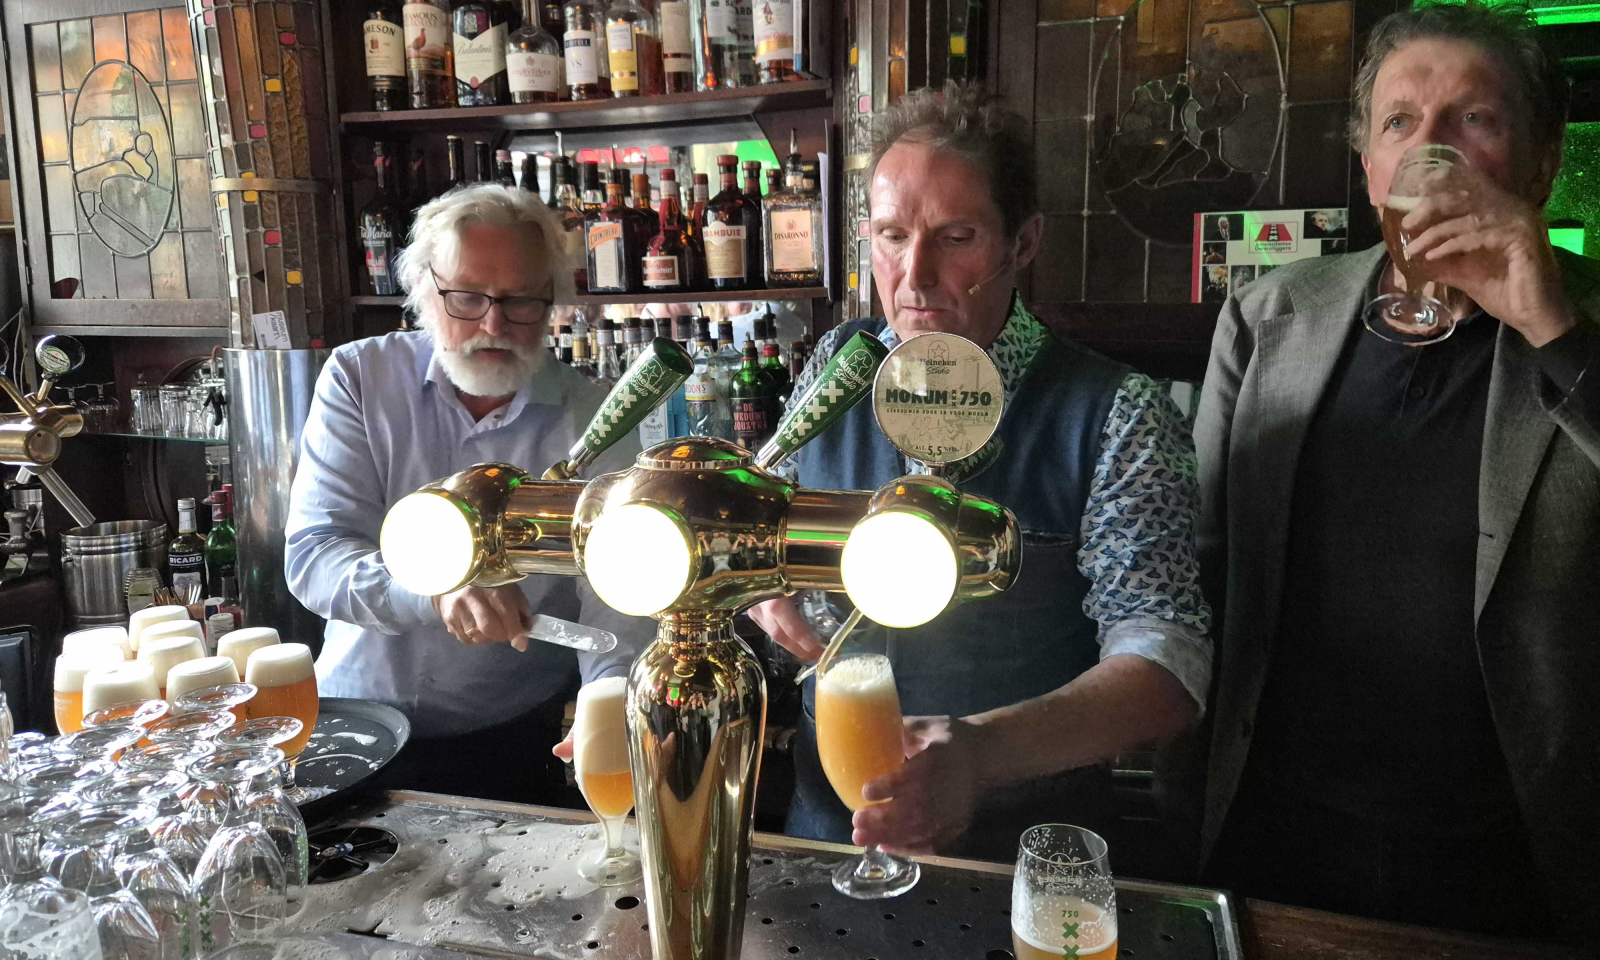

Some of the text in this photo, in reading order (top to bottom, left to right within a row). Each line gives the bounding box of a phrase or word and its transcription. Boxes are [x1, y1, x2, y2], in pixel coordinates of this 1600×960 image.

[590, 228, 619, 247] COINTREAU
[774, 231, 809, 240] DISARONNO
[926, 366, 950, 376] Studio
[832, 367, 857, 391] Studio
[960, 391, 992, 407] 750
[927, 445, 943, 458] 5,5
[169, 555, 202, 564] RICARD
[1061, 910, 1080, 918] 750
